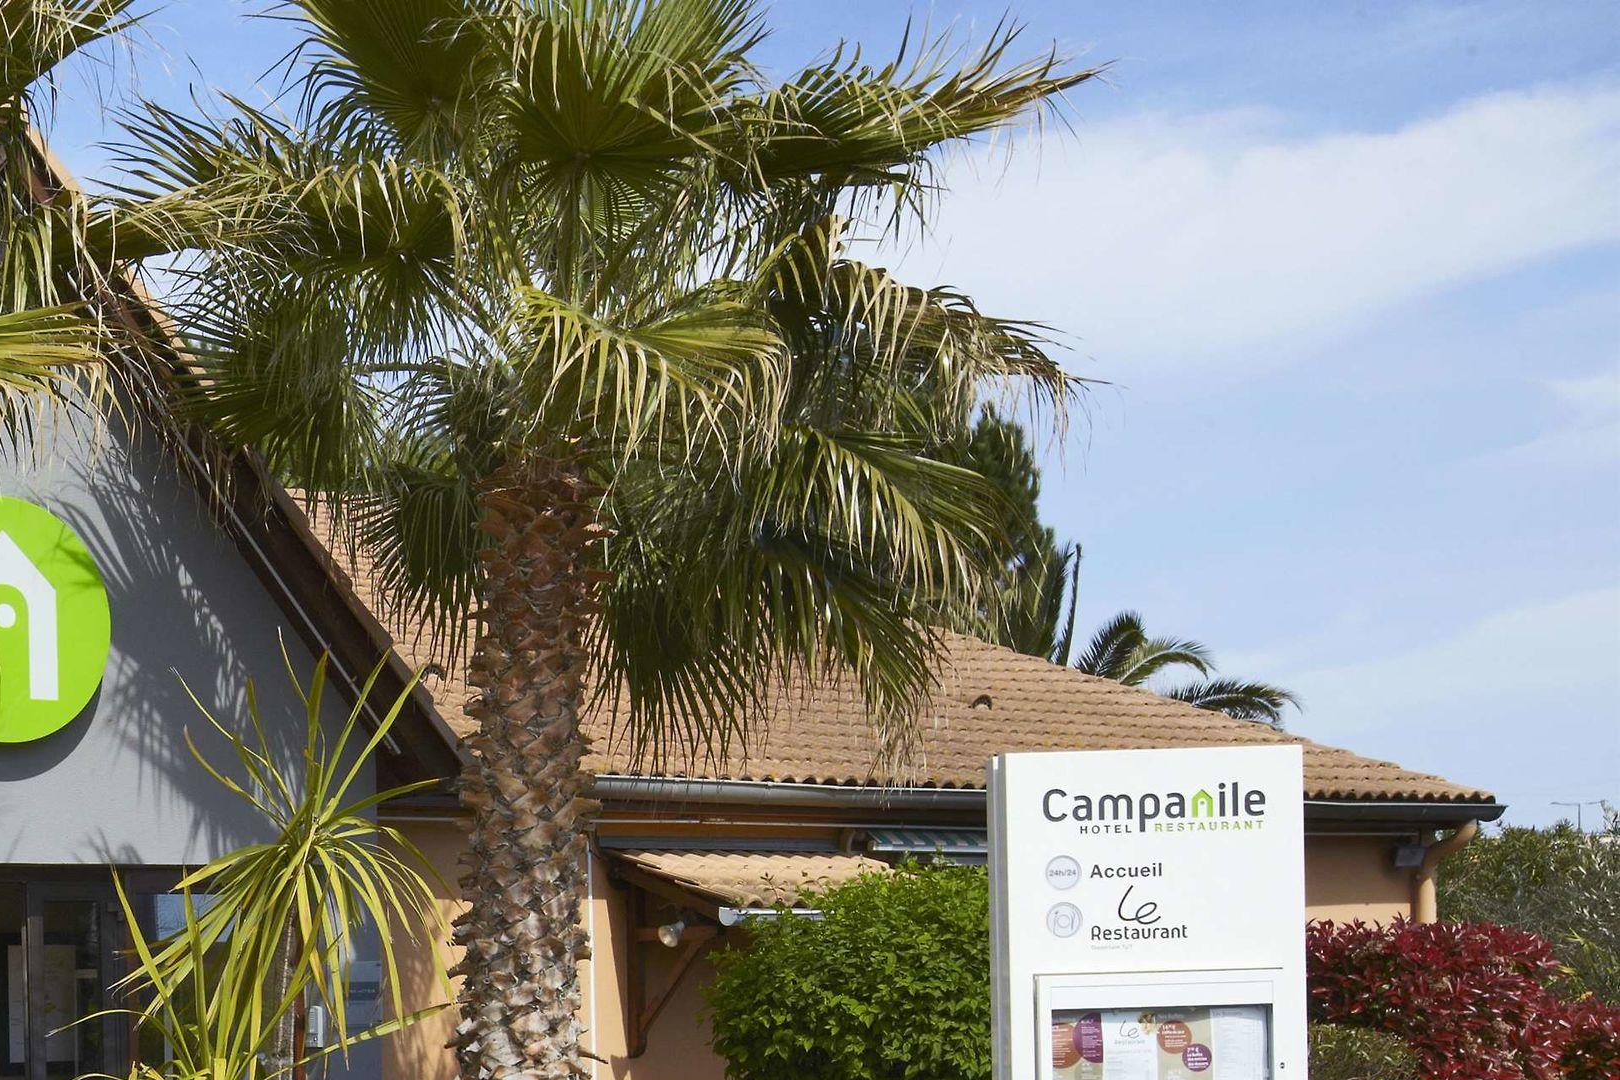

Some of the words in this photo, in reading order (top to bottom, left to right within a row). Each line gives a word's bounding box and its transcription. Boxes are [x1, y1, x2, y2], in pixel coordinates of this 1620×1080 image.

[1042, 781, 1267, 833] Campanile
[1079, 823, 1133, 835] HOTEL
[1154, 819, 1265, 833] RESTAURANT
[1048, 868, 1077, 877] 24h/24
[1090, 862, 1163, 878] Accueil
[1117, 885, 1162, 925] Le
[1091, 924, 1189, 941] Restaurant
